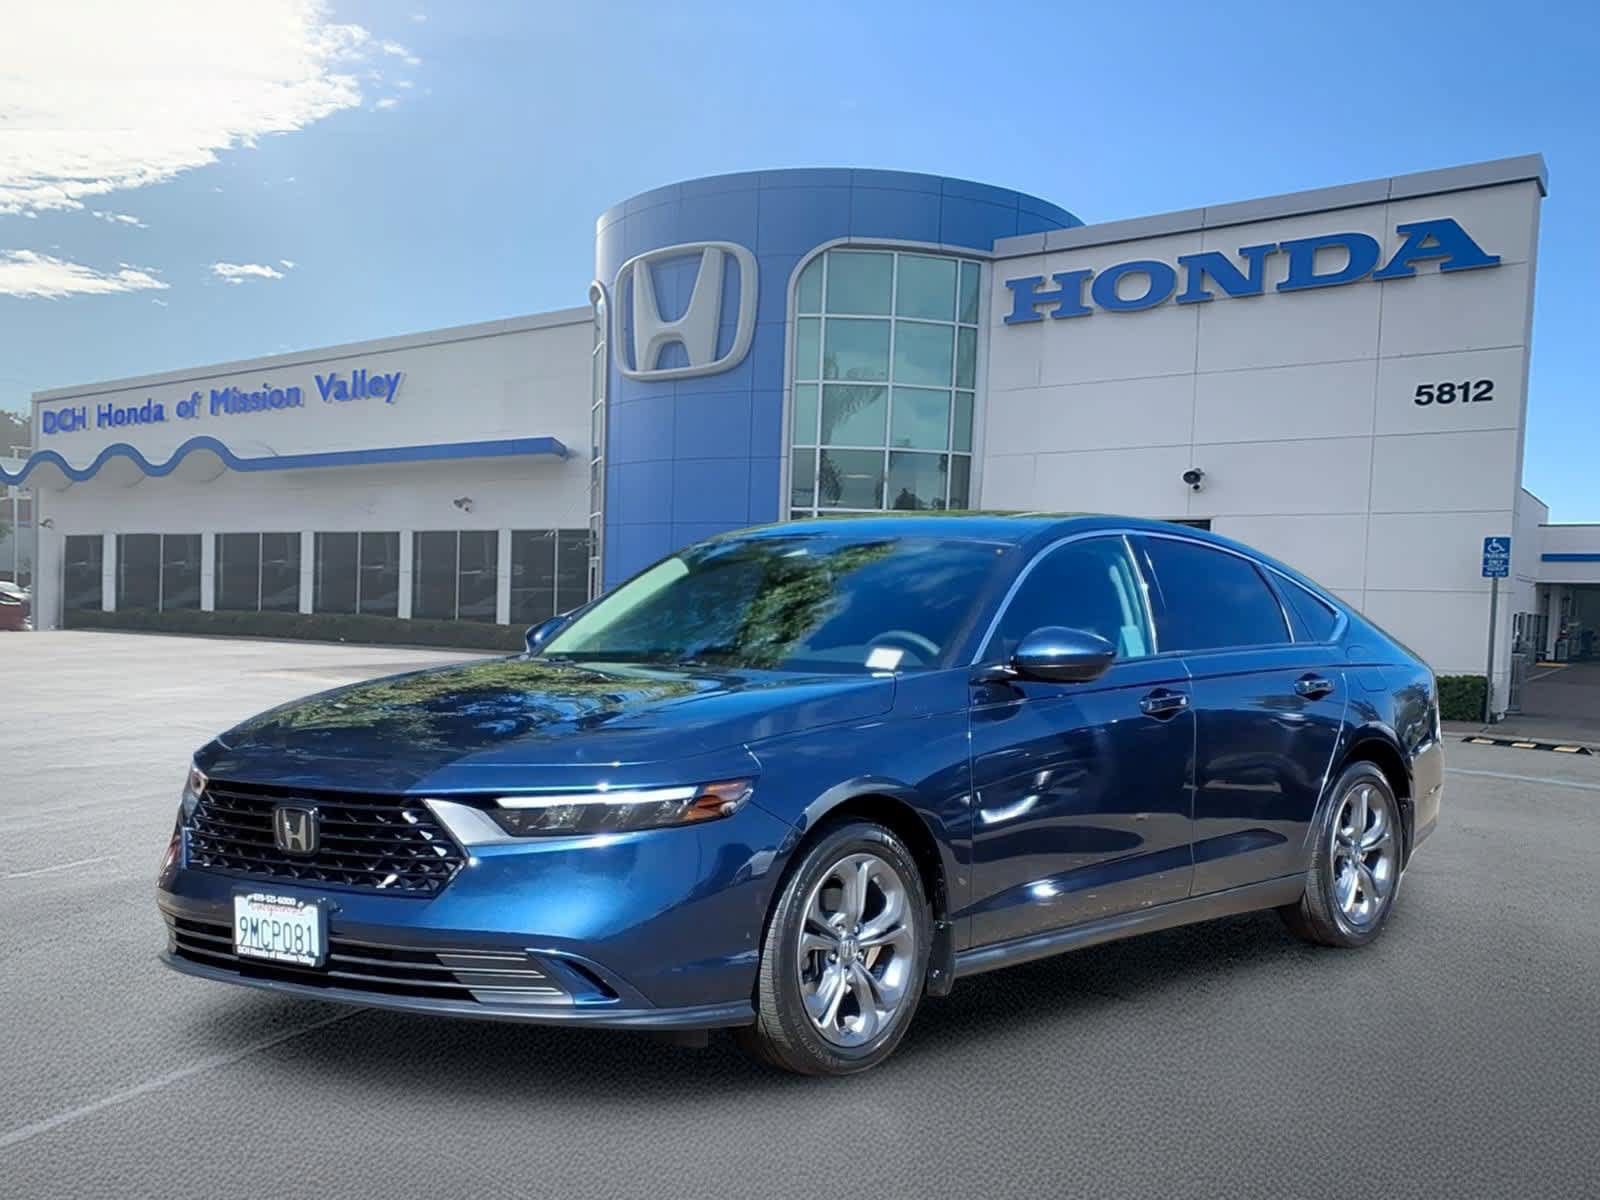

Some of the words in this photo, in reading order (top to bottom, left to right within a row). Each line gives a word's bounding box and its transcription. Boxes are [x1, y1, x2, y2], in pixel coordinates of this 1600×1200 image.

[1004, 217, 1502, 325] HONDA
[42, 408, 87, 434] DCH
[97, 401, 165, 429] Honda
[176, 394, 200, 420] of
[209, 383, 303, 415] Mission
[315, 369, 402, 405] Valley
[1413, 380, 1494, 405] 5812
[239, 915, 312, 957] 9MCP081
